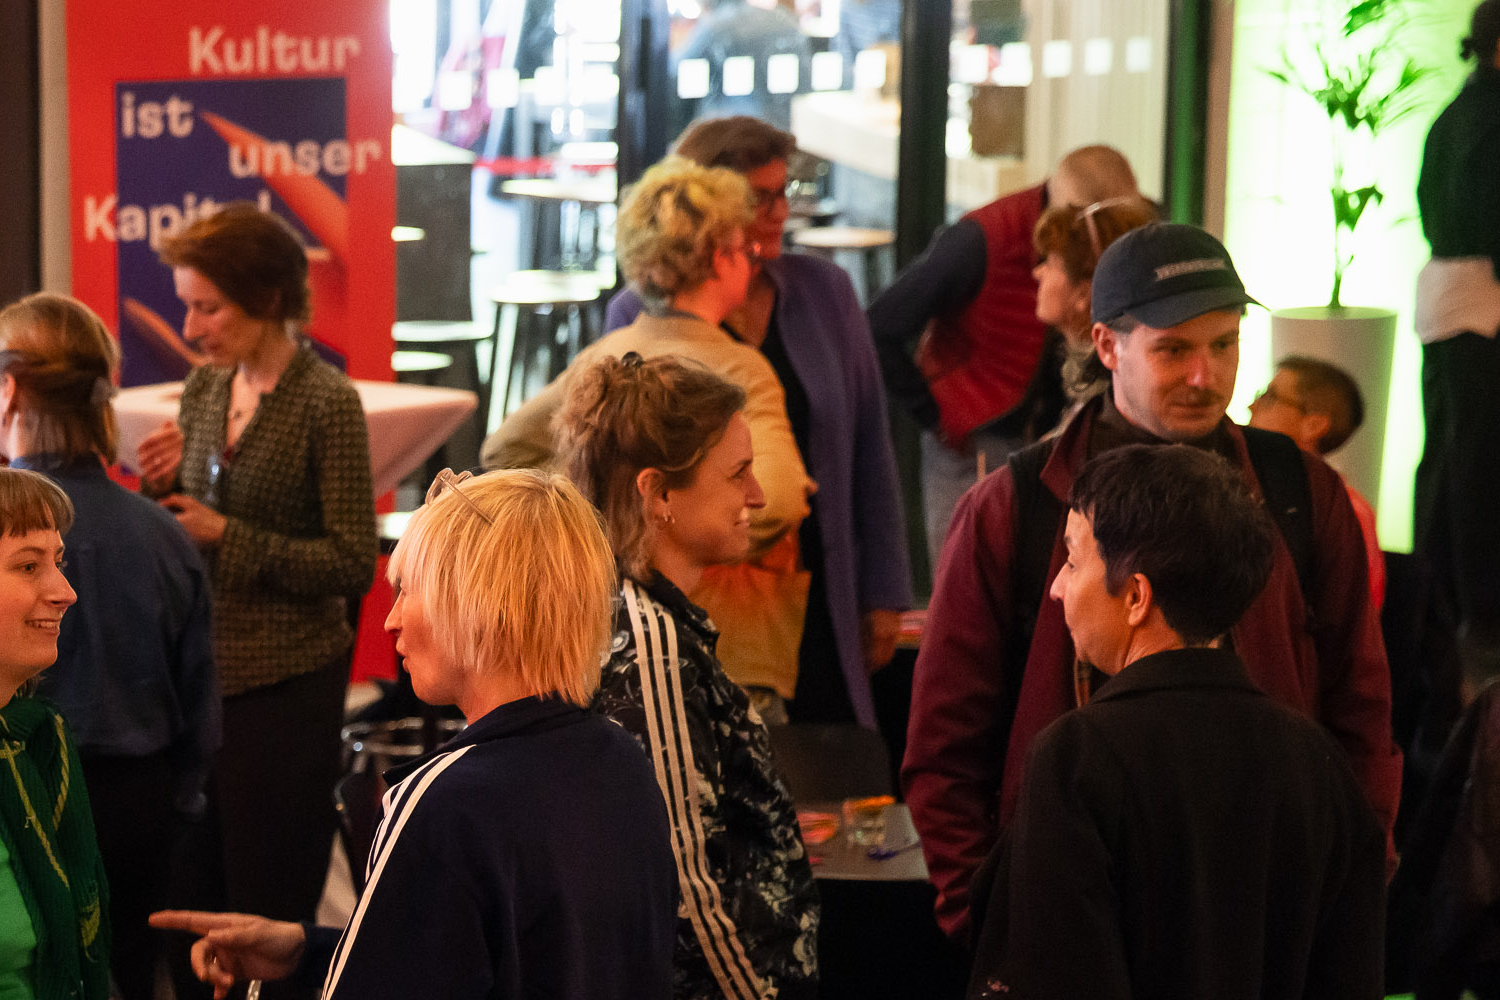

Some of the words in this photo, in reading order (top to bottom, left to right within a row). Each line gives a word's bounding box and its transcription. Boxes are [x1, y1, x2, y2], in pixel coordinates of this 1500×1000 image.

[188, 26, 362, 74] Kultur
[121, 91, 195, 138] ist
[228, 139, 382, 178] unser
